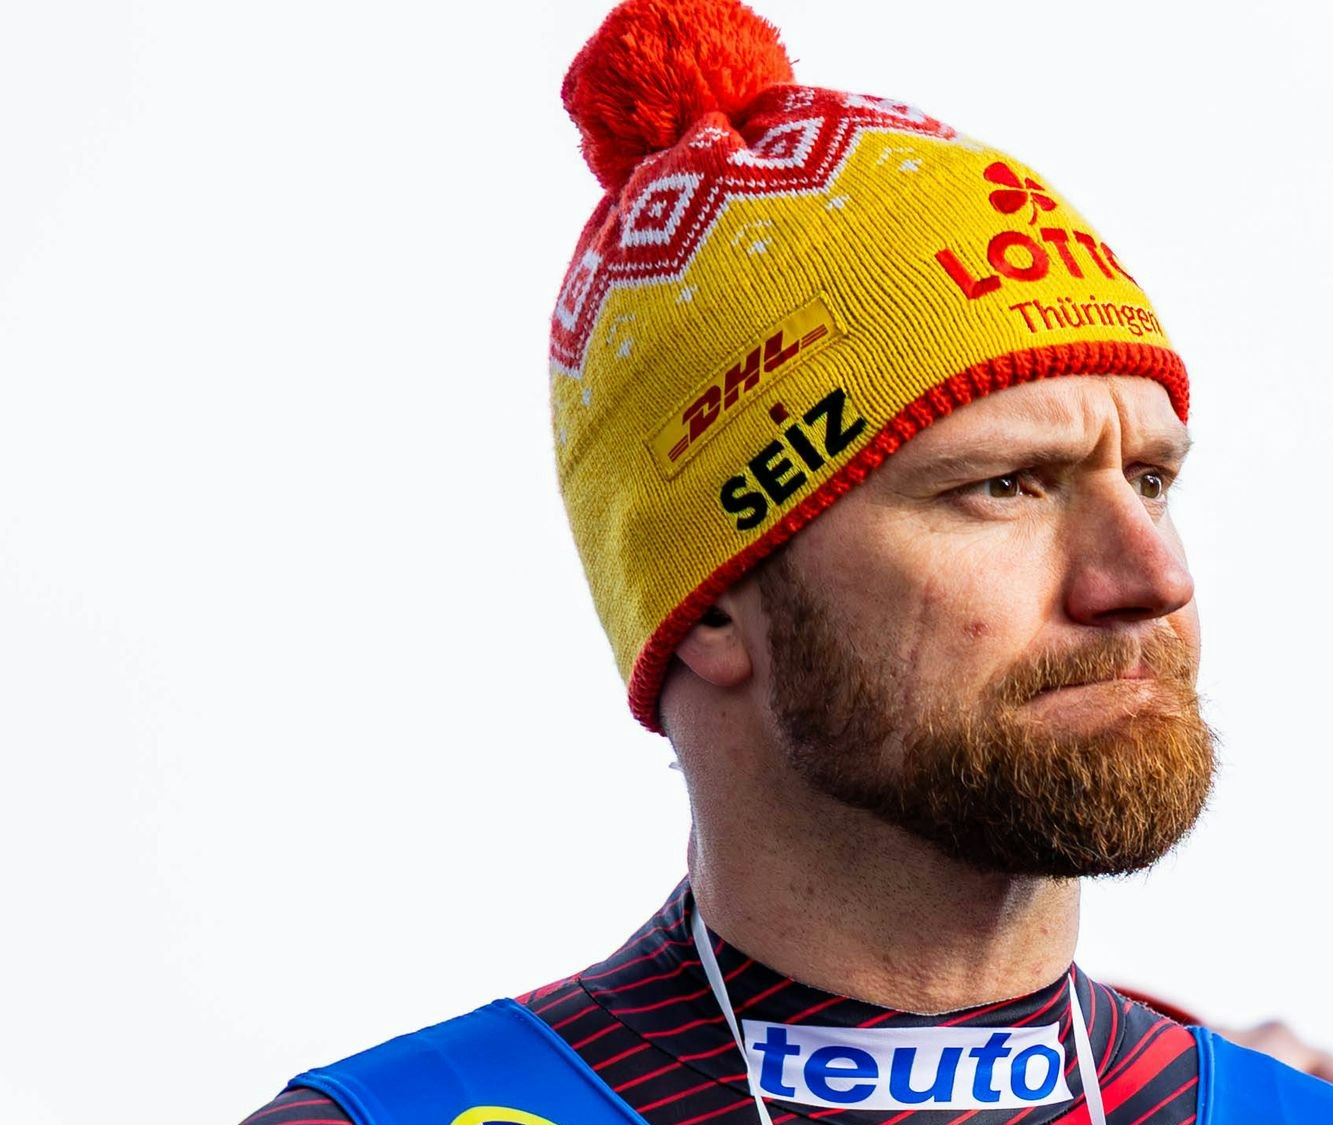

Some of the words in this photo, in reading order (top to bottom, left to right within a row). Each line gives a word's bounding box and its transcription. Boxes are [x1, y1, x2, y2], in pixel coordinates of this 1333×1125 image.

[934, 228, 1143, 301] LOTT
[1009, 295, 1163, 337] Thüringen
[682, 330, 800, 444] DHL
[720, 387, 867, 531] SEIZ
[752, 1026, 1061, 1104] teuto
